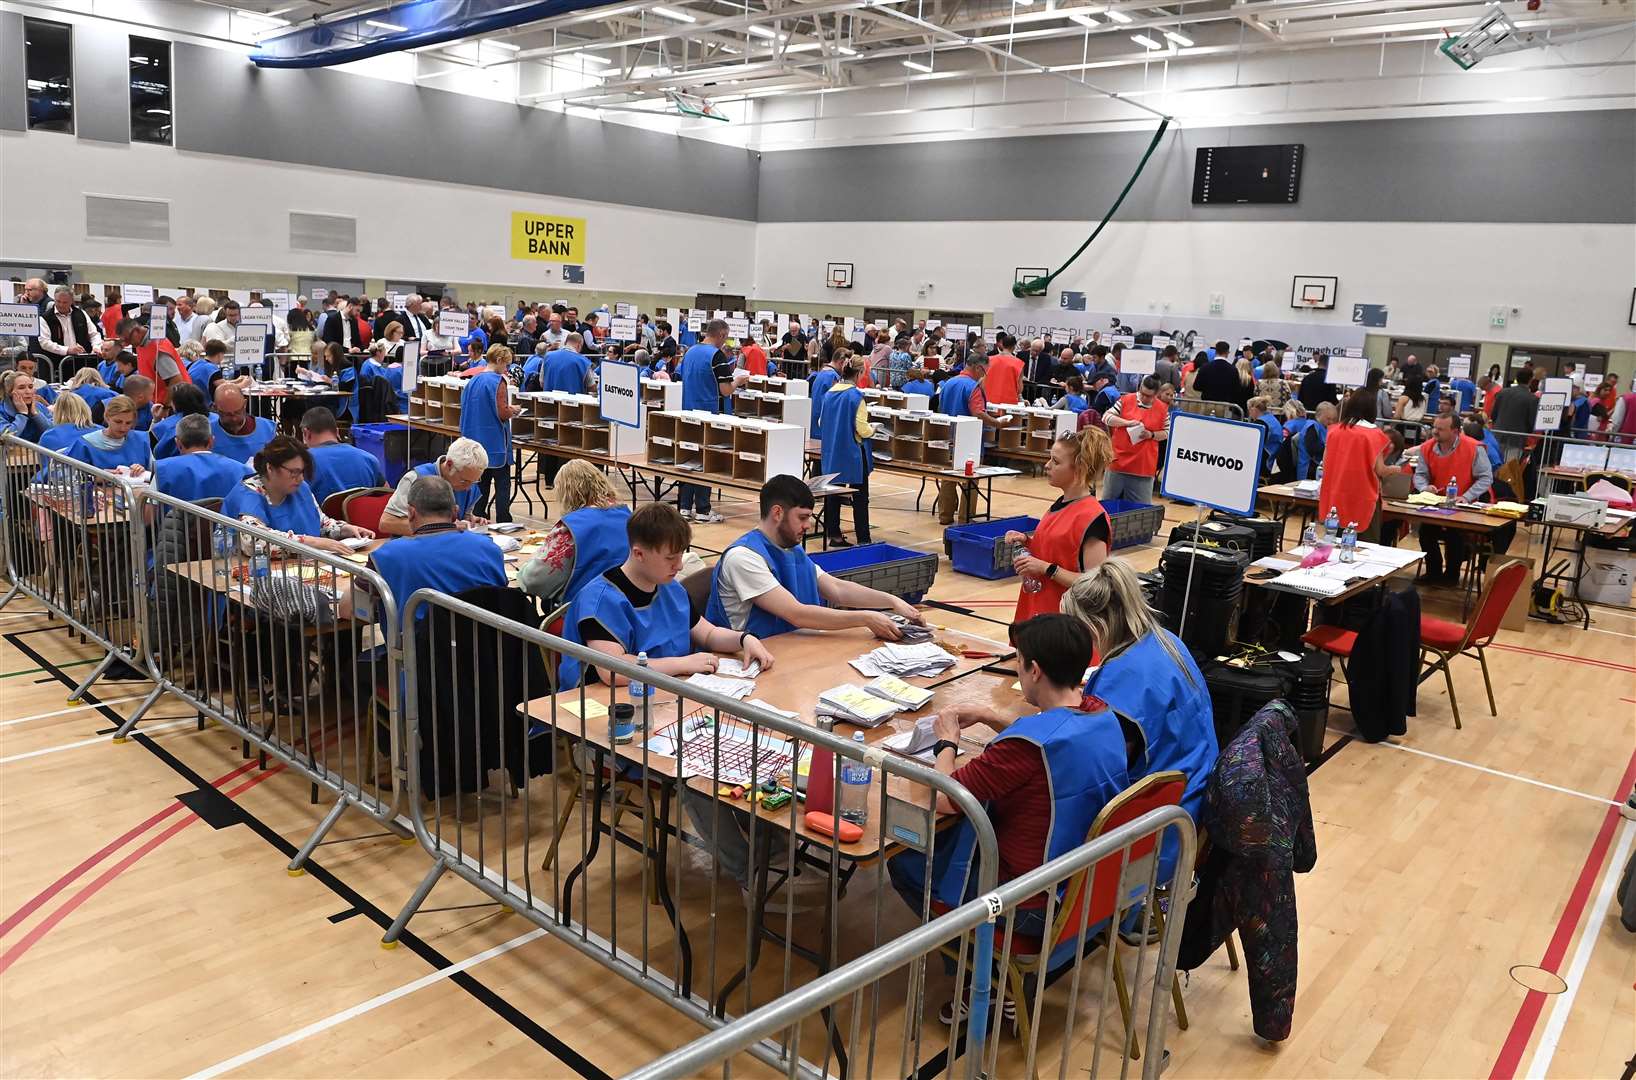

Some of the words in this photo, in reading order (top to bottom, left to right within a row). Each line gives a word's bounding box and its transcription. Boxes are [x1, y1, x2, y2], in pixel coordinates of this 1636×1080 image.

[525, 220, 574, 240] UPPER
[528, 238, 570, 257] BANN
[1061, 295, 1069, 306] 3
[1354, 309, 1363, 321] 2
[1006, 324, 1036, 338] OUR
[249, 335, 264, 343] VALLEY
[1332, 347, 1346, 356] Cit
[604, 384, 634, 398] EASTWOOD
[1542, 416, 1555, 424] TABLE
[1176, 447, 1244, 471] EASTWOOD
[682, 761, 745, 783] DOUTFUL
[988, 896, 1000, 915] 25
